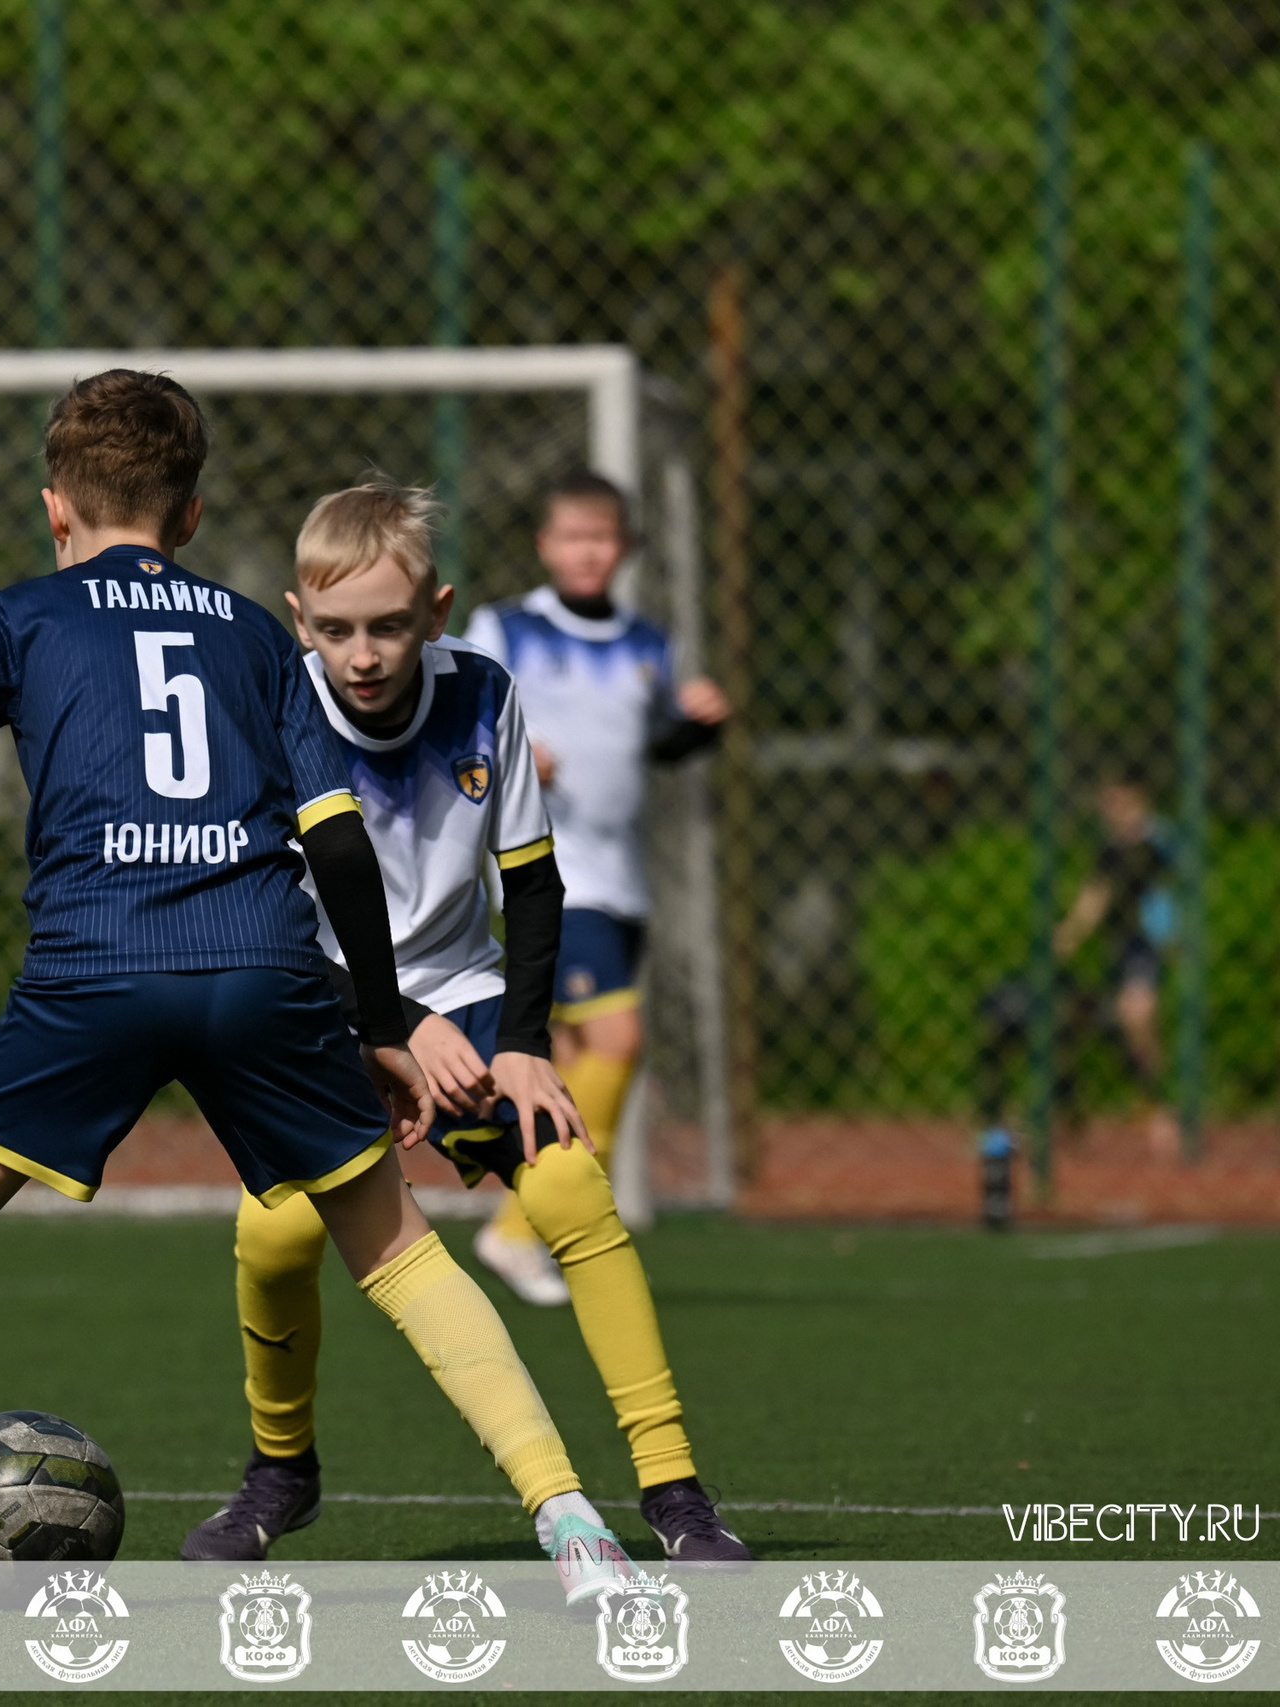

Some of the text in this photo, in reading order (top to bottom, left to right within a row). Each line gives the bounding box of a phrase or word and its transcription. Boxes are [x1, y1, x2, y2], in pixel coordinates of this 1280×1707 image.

[82, 579, 234, 621] ТАЛАЙКО
[133, 630, 210, 799] 5
[104, 820, 249, 864] ЮНИОР
